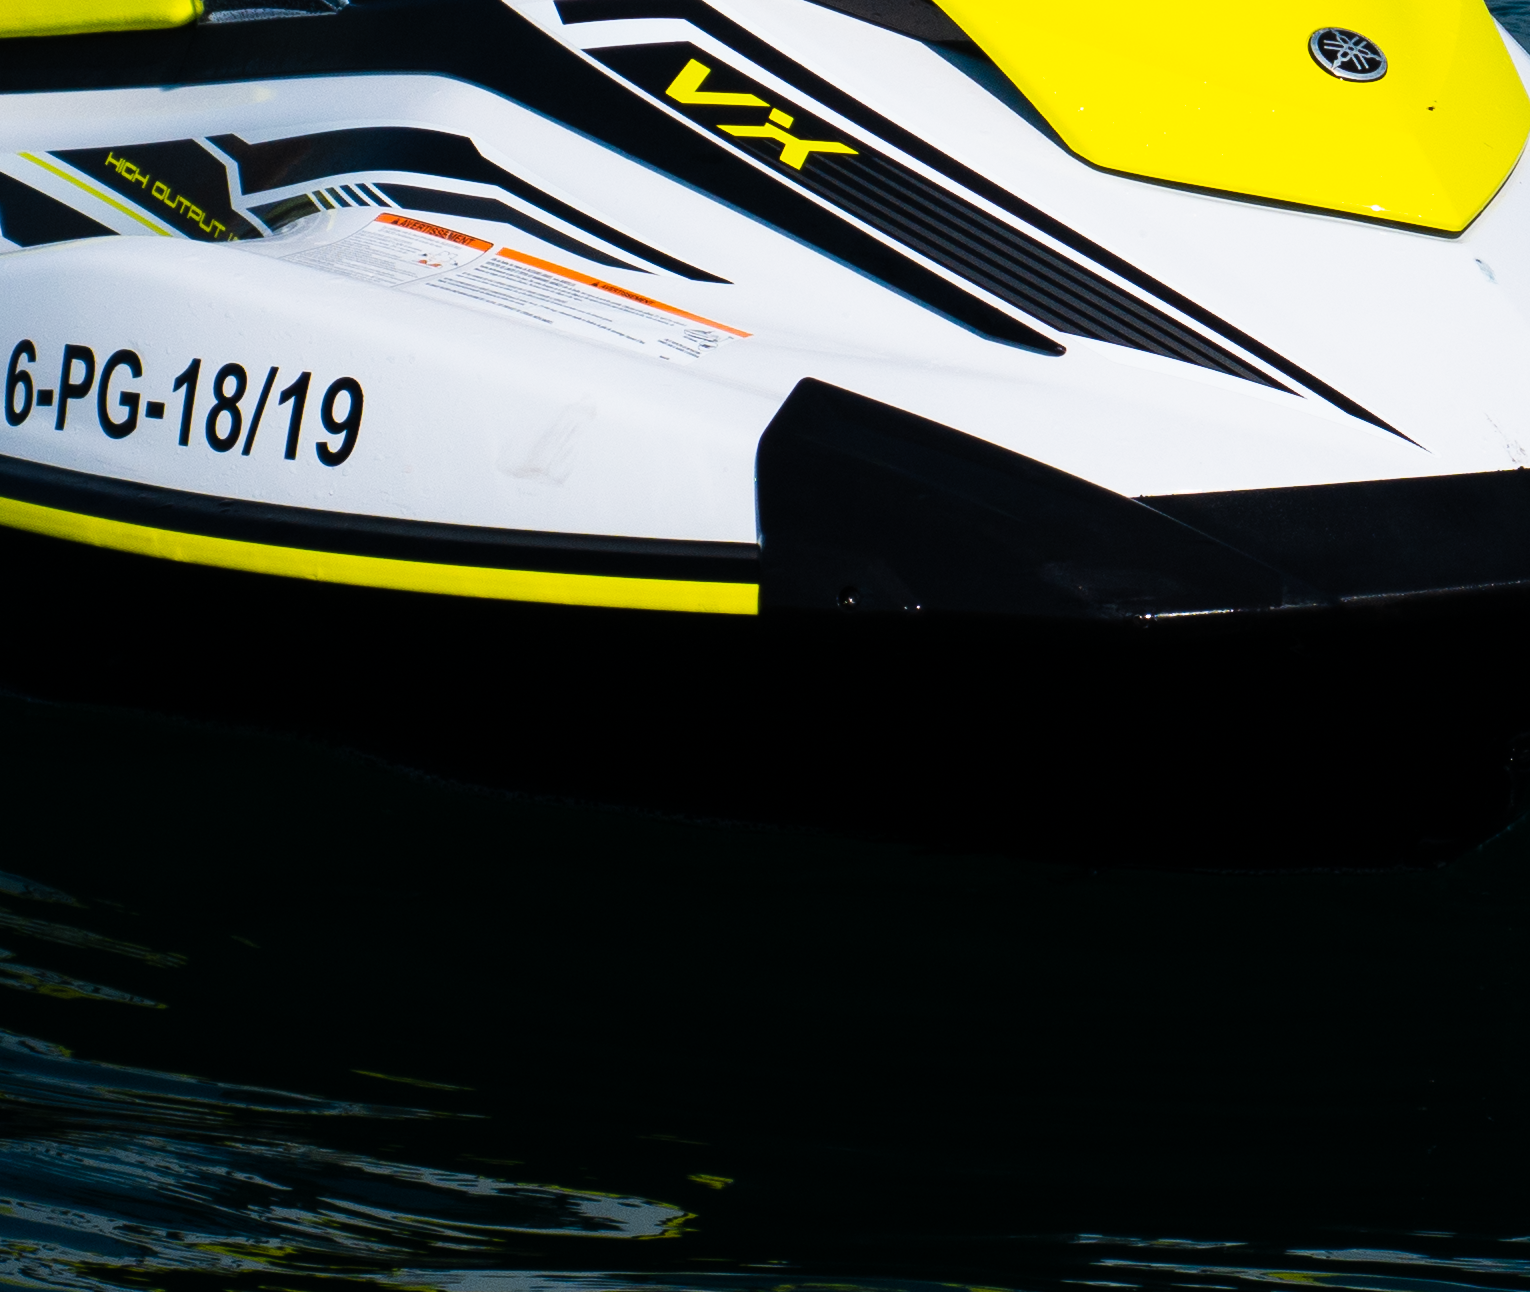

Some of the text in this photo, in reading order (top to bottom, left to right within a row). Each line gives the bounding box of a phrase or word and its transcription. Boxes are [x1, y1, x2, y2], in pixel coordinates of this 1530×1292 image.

[665, 58, 860, 170] VX
[104, 151, 226, 239] HIGH OUTPUT
[398, 218, 476, 246] AVERTISSEMENT
[600, 284, 656, 306] AVERTISSEMENT
[4, 338, 365, 468] 6-PG-18/19
